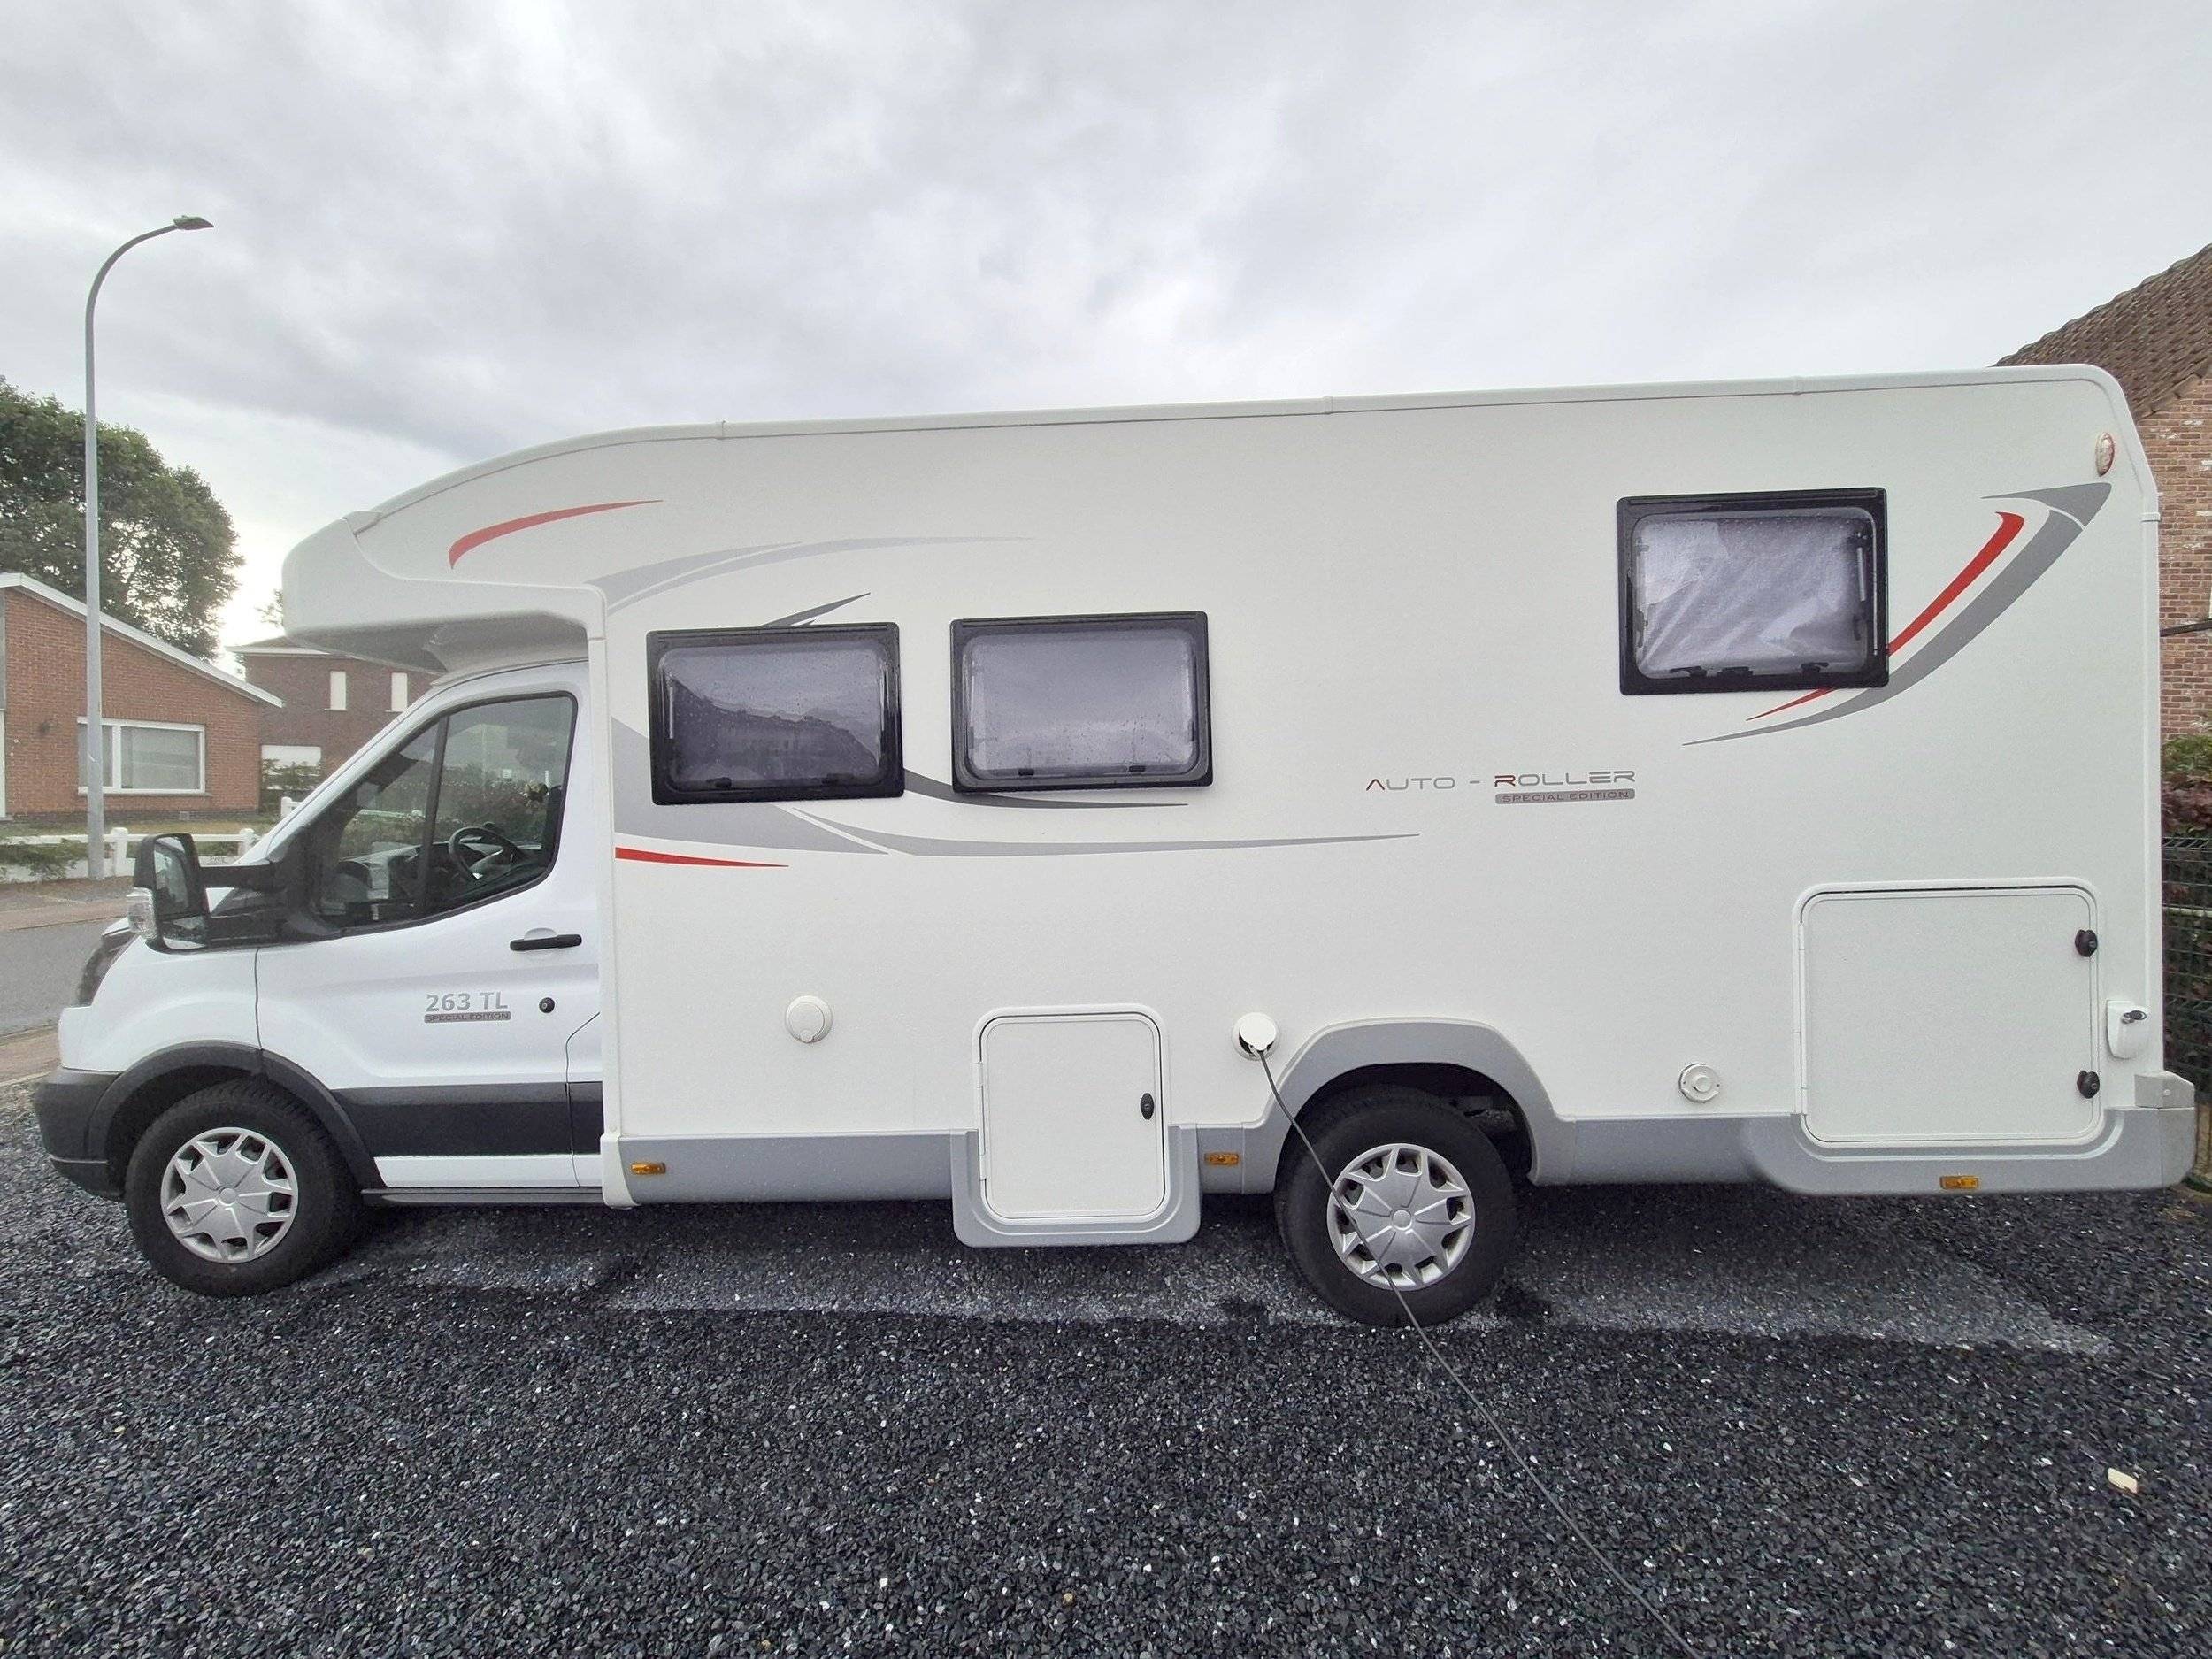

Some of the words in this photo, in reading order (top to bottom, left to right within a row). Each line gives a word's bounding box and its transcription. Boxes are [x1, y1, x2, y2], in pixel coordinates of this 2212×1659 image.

[1365, 777, 1455, 791] AUTO
[1494, 771, 1636, 787] ROLLER
[1502, 793, 1563, 803] SPECIAL
[1569, 791, 1629, 800] EDITION
[426, 993, 471, 1012] 263
[480, 991, 508, 1010] TL
